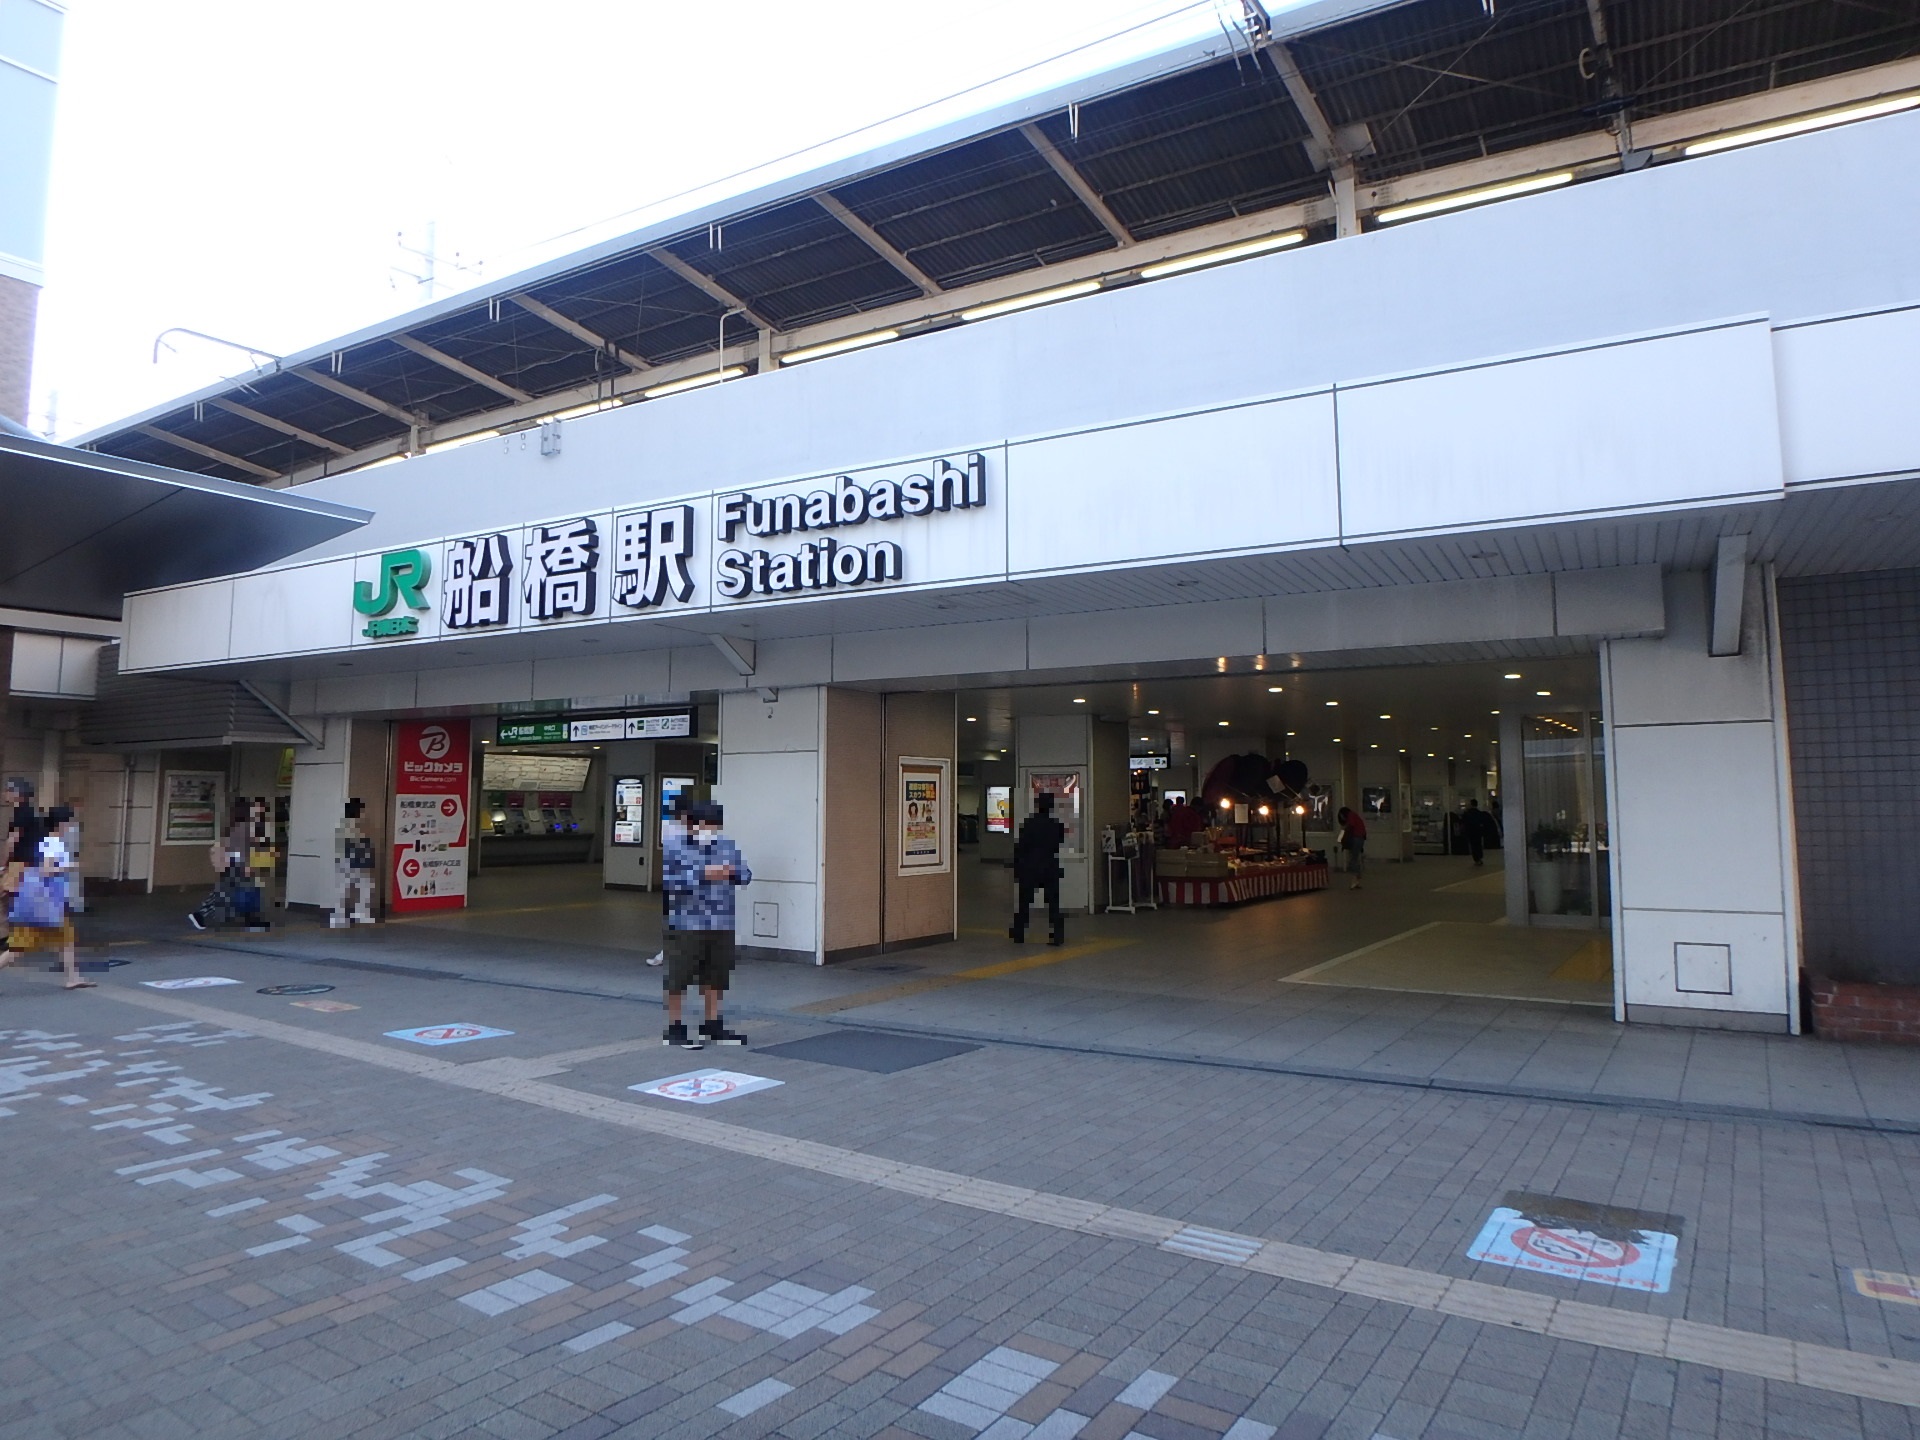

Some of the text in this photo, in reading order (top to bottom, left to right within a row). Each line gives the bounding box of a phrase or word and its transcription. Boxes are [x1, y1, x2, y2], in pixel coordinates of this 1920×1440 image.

[717, 453, 987, 542] Funabashi
[354, 549, 432, 617] JR
[441, 504, 696, 629] 船橋駅
[716, 537, 903, 598] Station
[404, 761, 463, 773] ビックカメラ
